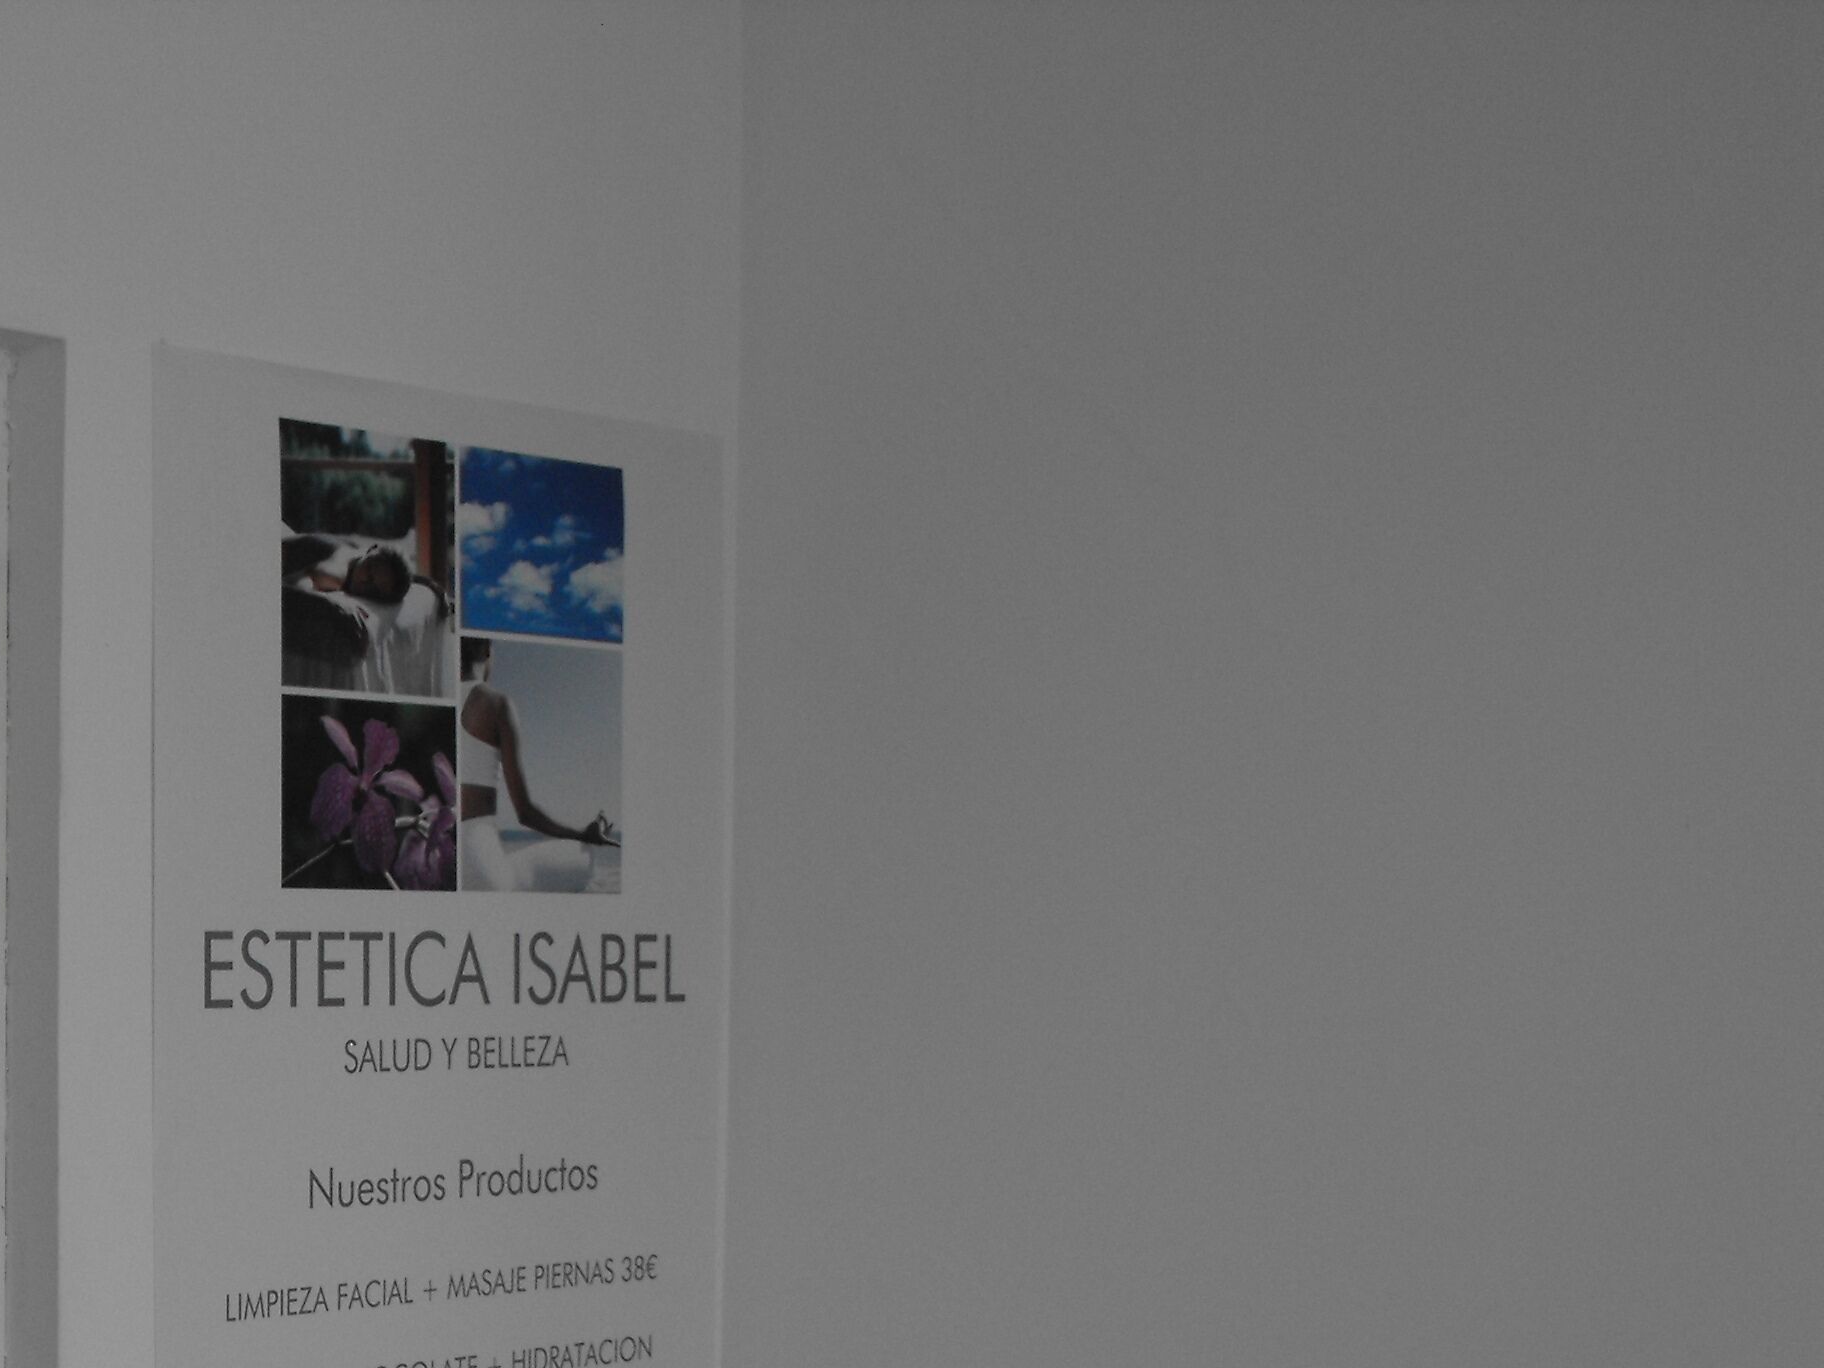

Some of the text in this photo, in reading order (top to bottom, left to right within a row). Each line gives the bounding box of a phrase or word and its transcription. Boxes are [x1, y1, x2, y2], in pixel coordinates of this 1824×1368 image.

[203, 929, 687, 1009] ESTETICA ISABEL
[344, 1035, 569, 1074] SALUD Y BELLEZA
[308, 1153, 598, 1209] Nuestros Productos
[226, 1253, 659, 1322] LIMPIEZA FACIAL + MASAJE PIERNAS 38€
